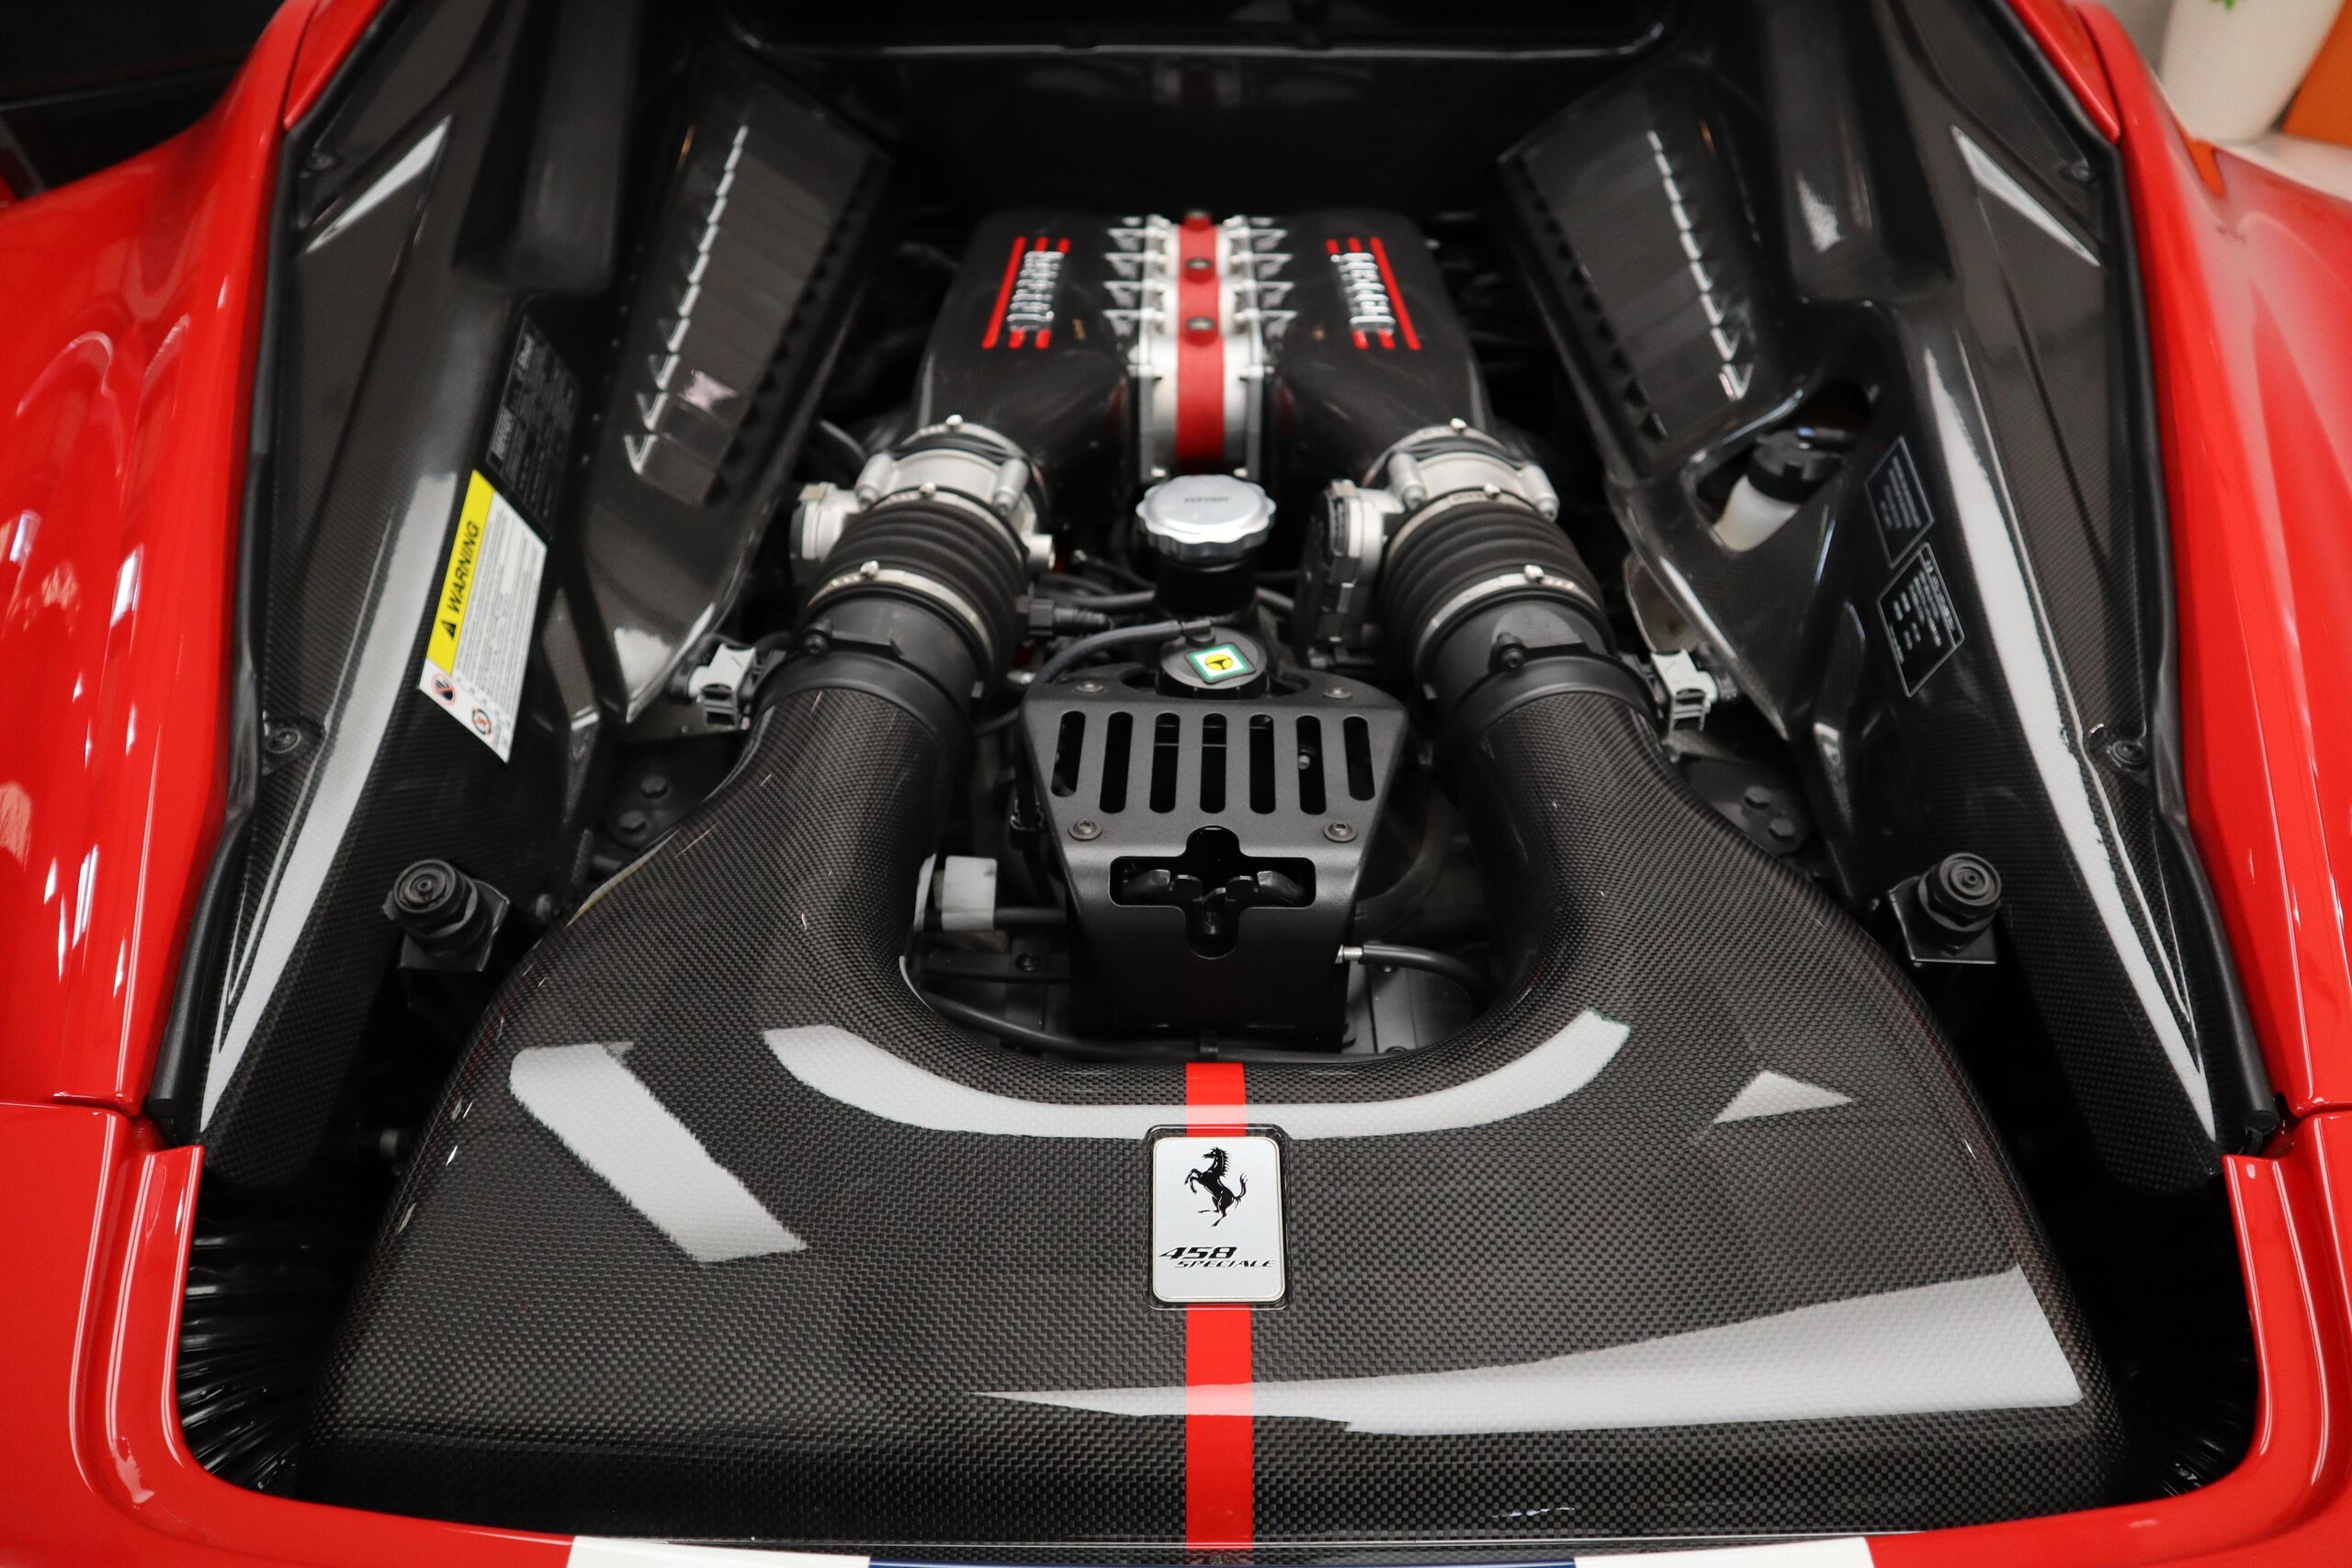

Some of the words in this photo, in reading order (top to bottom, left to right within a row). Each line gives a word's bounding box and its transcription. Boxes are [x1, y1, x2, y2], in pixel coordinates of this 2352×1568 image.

[447, 520, 480, 614] WARNING
[1159, 1246, 1238, 1260] 458
[1174, 1259, 1277, 1269] SPECIALE
